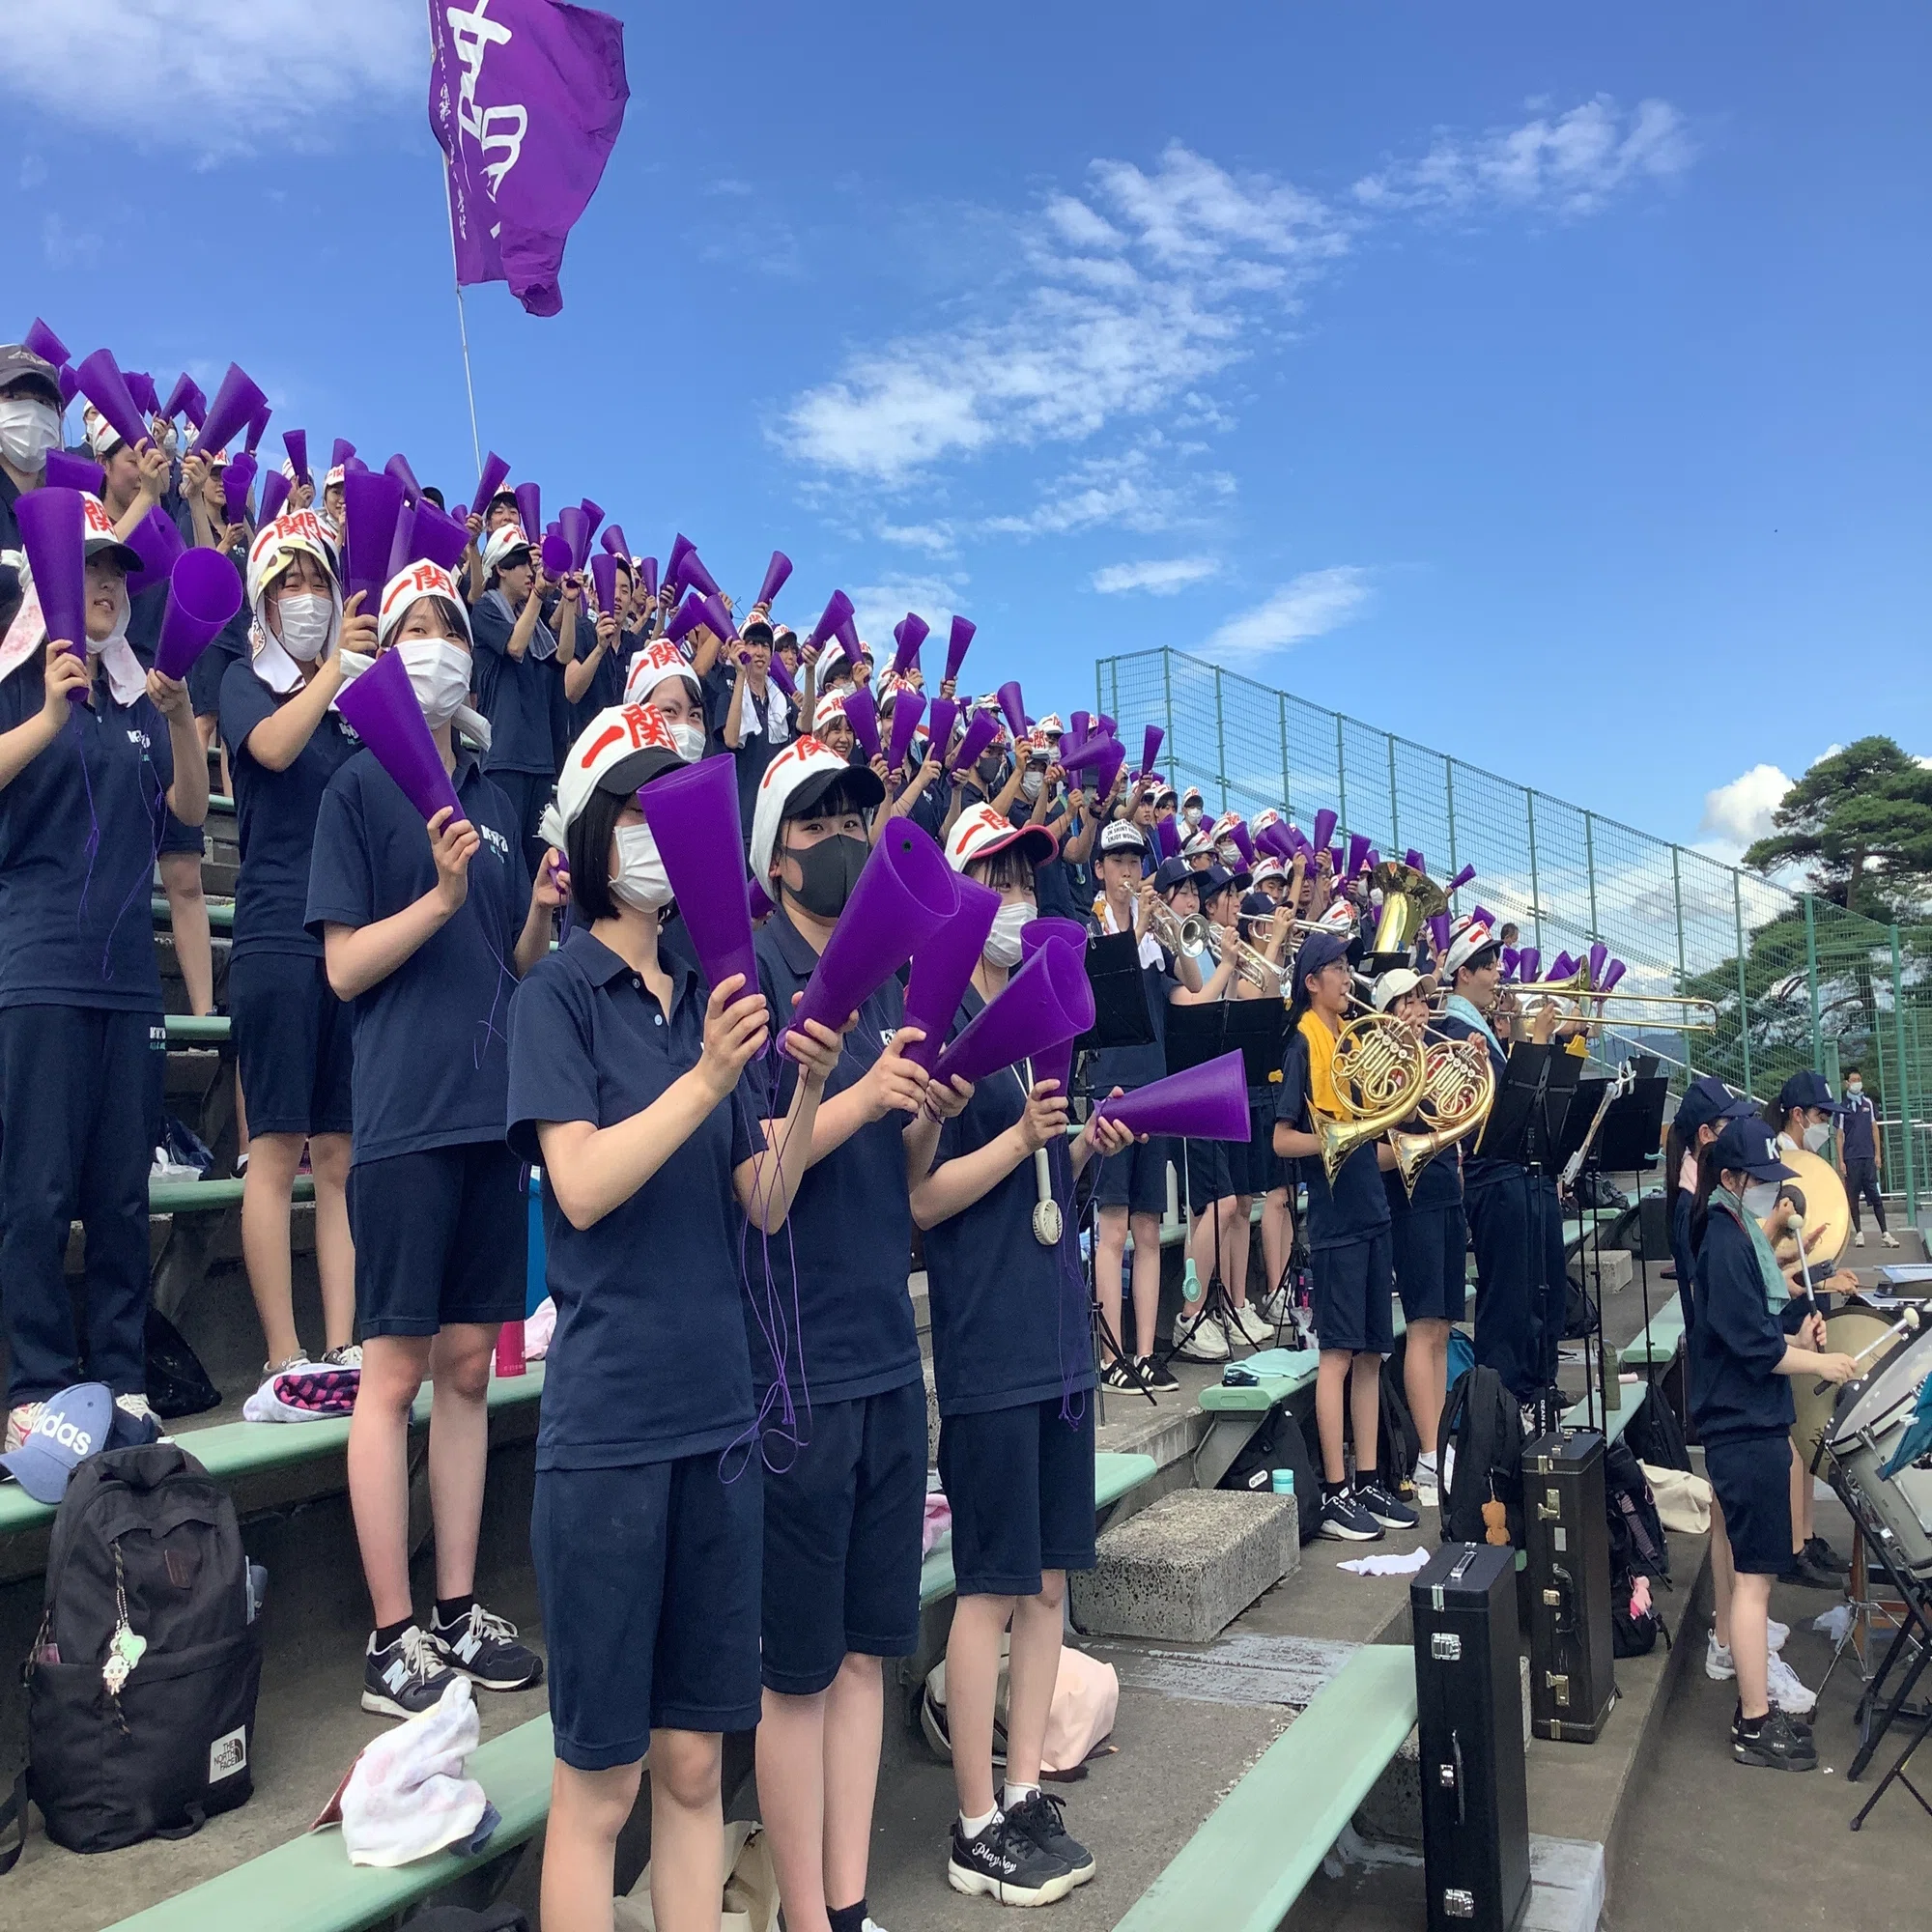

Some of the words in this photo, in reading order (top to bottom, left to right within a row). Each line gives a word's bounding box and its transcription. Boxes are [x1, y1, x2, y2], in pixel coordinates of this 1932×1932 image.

[383, 564, 457, 614] 一関
[628, 641, 686, 690] 一関
[582, 702, 677, 769] 一関
[762, 734, 839, 789] 一関
[1765, 1137, 1780, 1160] K
[451, 1630, 483, 1665] N
[382, 1658, 411, 1695] N
[213, 1749, 235, 1766] NORTH
[223, 1739, 235, 1750] THE
[219, 1756, 237, 1772] FACE
